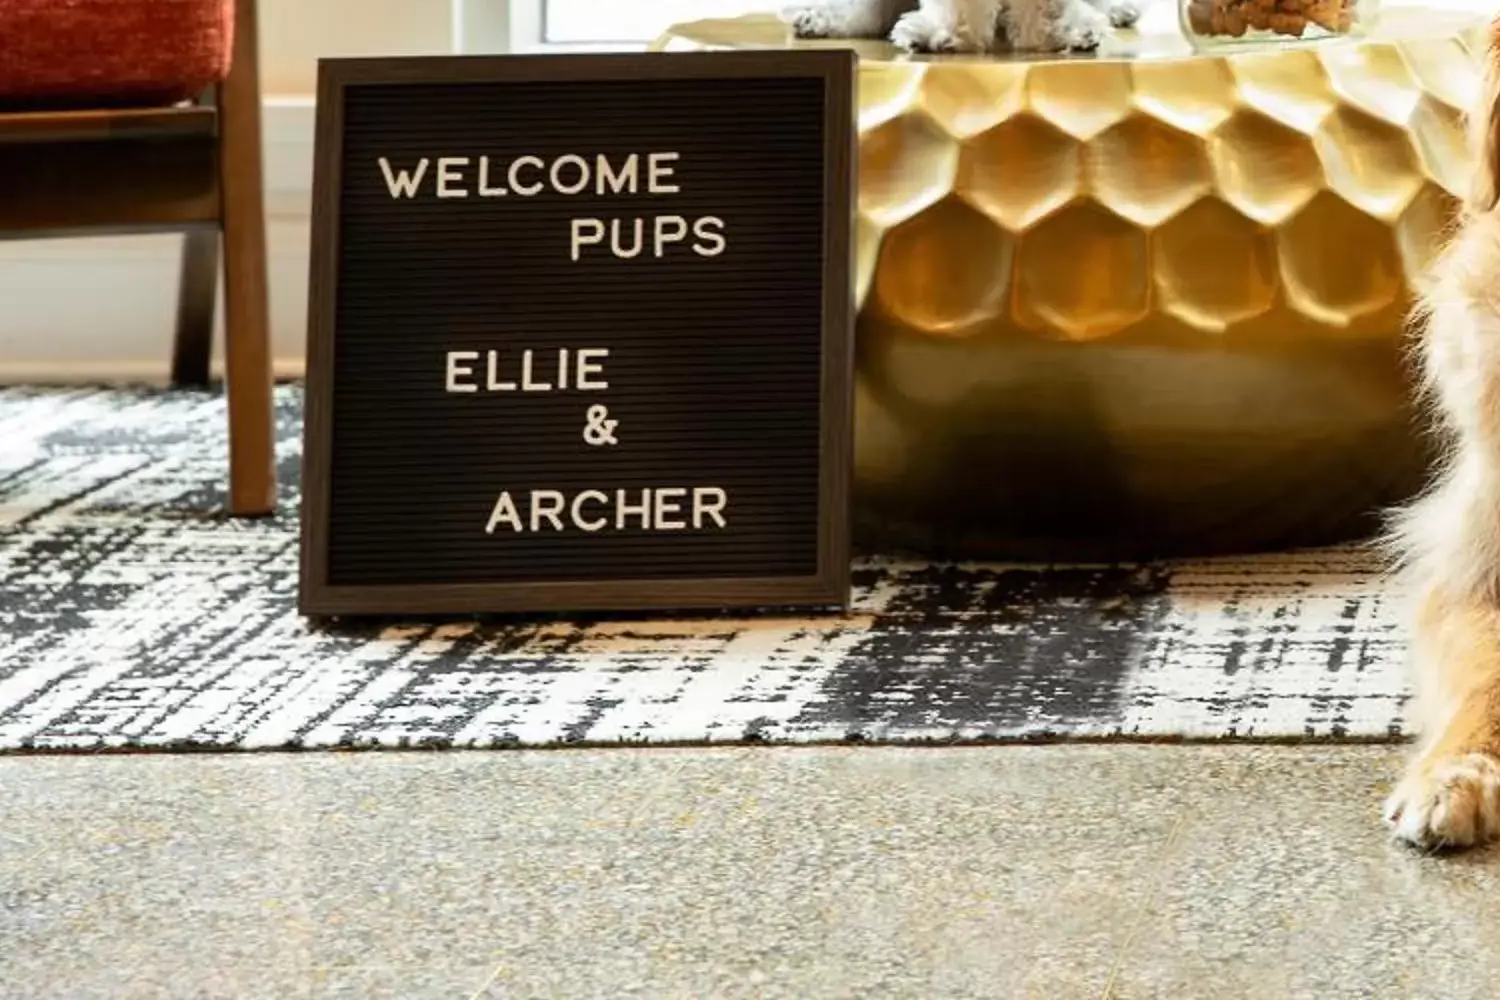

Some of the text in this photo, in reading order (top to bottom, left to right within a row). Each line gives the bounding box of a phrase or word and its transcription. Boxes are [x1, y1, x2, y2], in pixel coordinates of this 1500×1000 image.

[379, 152, 679, 198] WELCOME
[572, 216, 725, 261] PUPS
[446, 349, 608, 392] ELLIE
[583, 404, 618, 445] &
[486, 488, 726, 533] ARCHER
